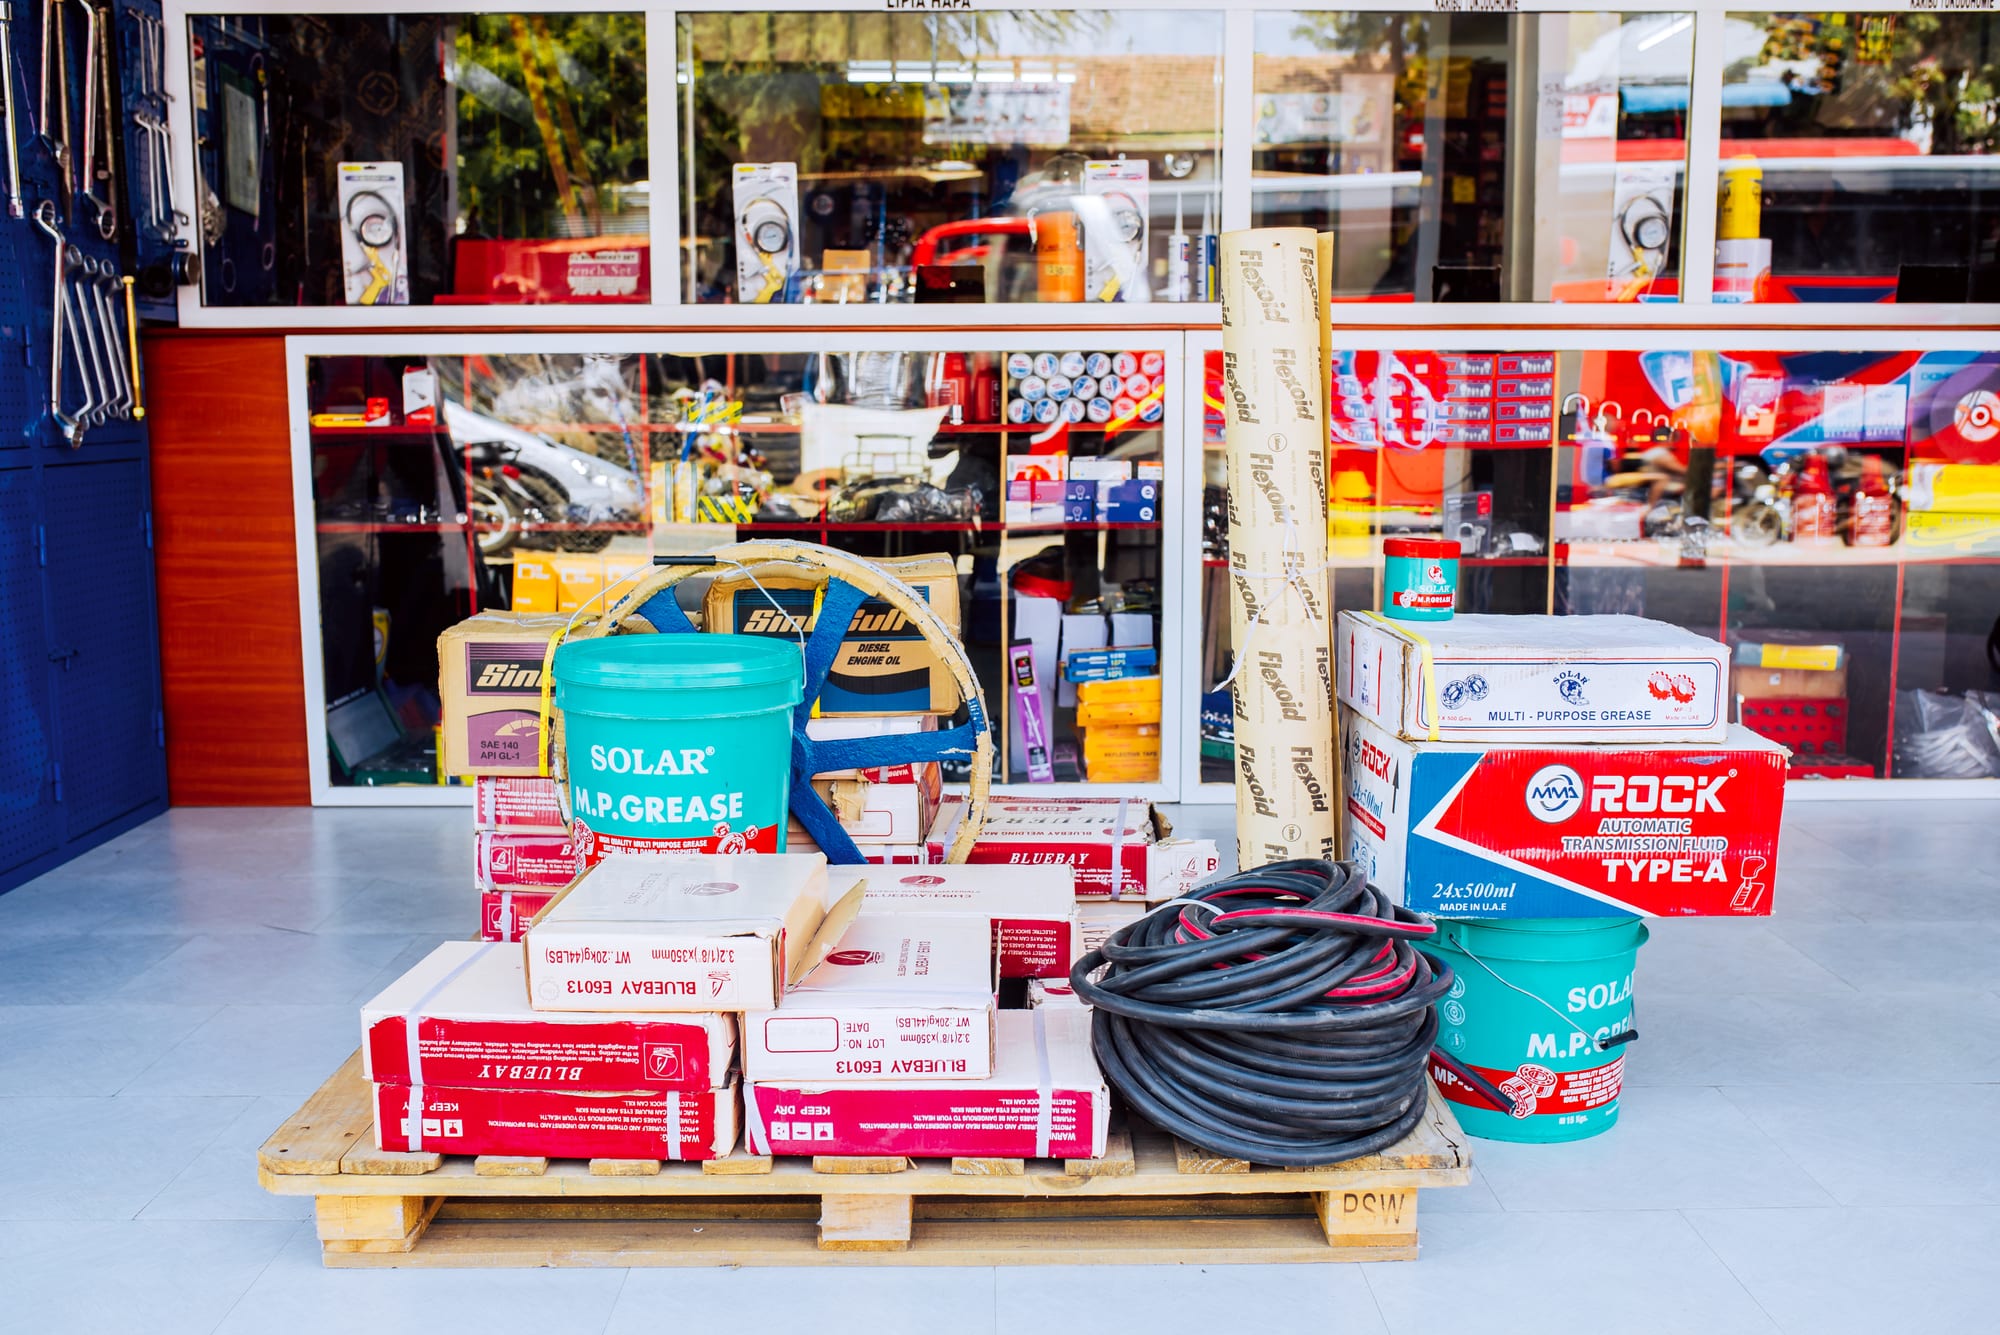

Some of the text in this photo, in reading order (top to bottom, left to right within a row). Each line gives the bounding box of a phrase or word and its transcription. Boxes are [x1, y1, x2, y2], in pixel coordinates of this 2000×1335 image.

[1240, 250, 1290, 324] Flexoid
[1225, 352, 1261, 424] Flexoid
[1272, 348, 1315, 421] Flexoid
[858, 643, 890, 652] DIESEL
[848, 656, 900, 665] ENGINE OIL
[1552, 670, 1589, 686] SOLAR
[1258, 651, 1306, 722] Flexoid
[1488, 711, 1526, 721] MULTI
[1537, 710, 1596, 721] PURPOSE
[1600, 710, 1651, 720] GREASE
[502, 741, 519, 750] 140
[1362, 739, 1390, 783] ROCK
[1240, 744, 1278, 818] Flexoid
[1291, 746, 1328, 812] Flexoid
[576, 786, 743, 823] M.P.GREASE
[1600, 818, 1691, 834] AUTOMATIC
[683, 840, 707, 848] GREASE
[1564, 837, 1728, 852] TRANSMISSION FLUID
[1009, 852, 1089, 864] BLUEBAY
[1602, 859, 1728, 882] TYPE-A
[1432, 882, 1516, 899] 24x500ml
[1440, 902, 1507, 911] MADE IN U.A.E
[567, 980, 696, 994] BLUEBAY E6013
[1567, 972, 1634, 1013] SOLA
[843, 1022, 869, 1032] DATE:
[867, 1039, 885, 1049] LOT
[477, 1065, 583, 1080] BLUEBAY
[836, 1059, 966, 1073] BLUEBAY E6013
[1434, 1066, 1474, 1092] MP-
[429, 1102, 459, 1111] KEEP
[774, 1105, 830, 1115] KEEP DRY
